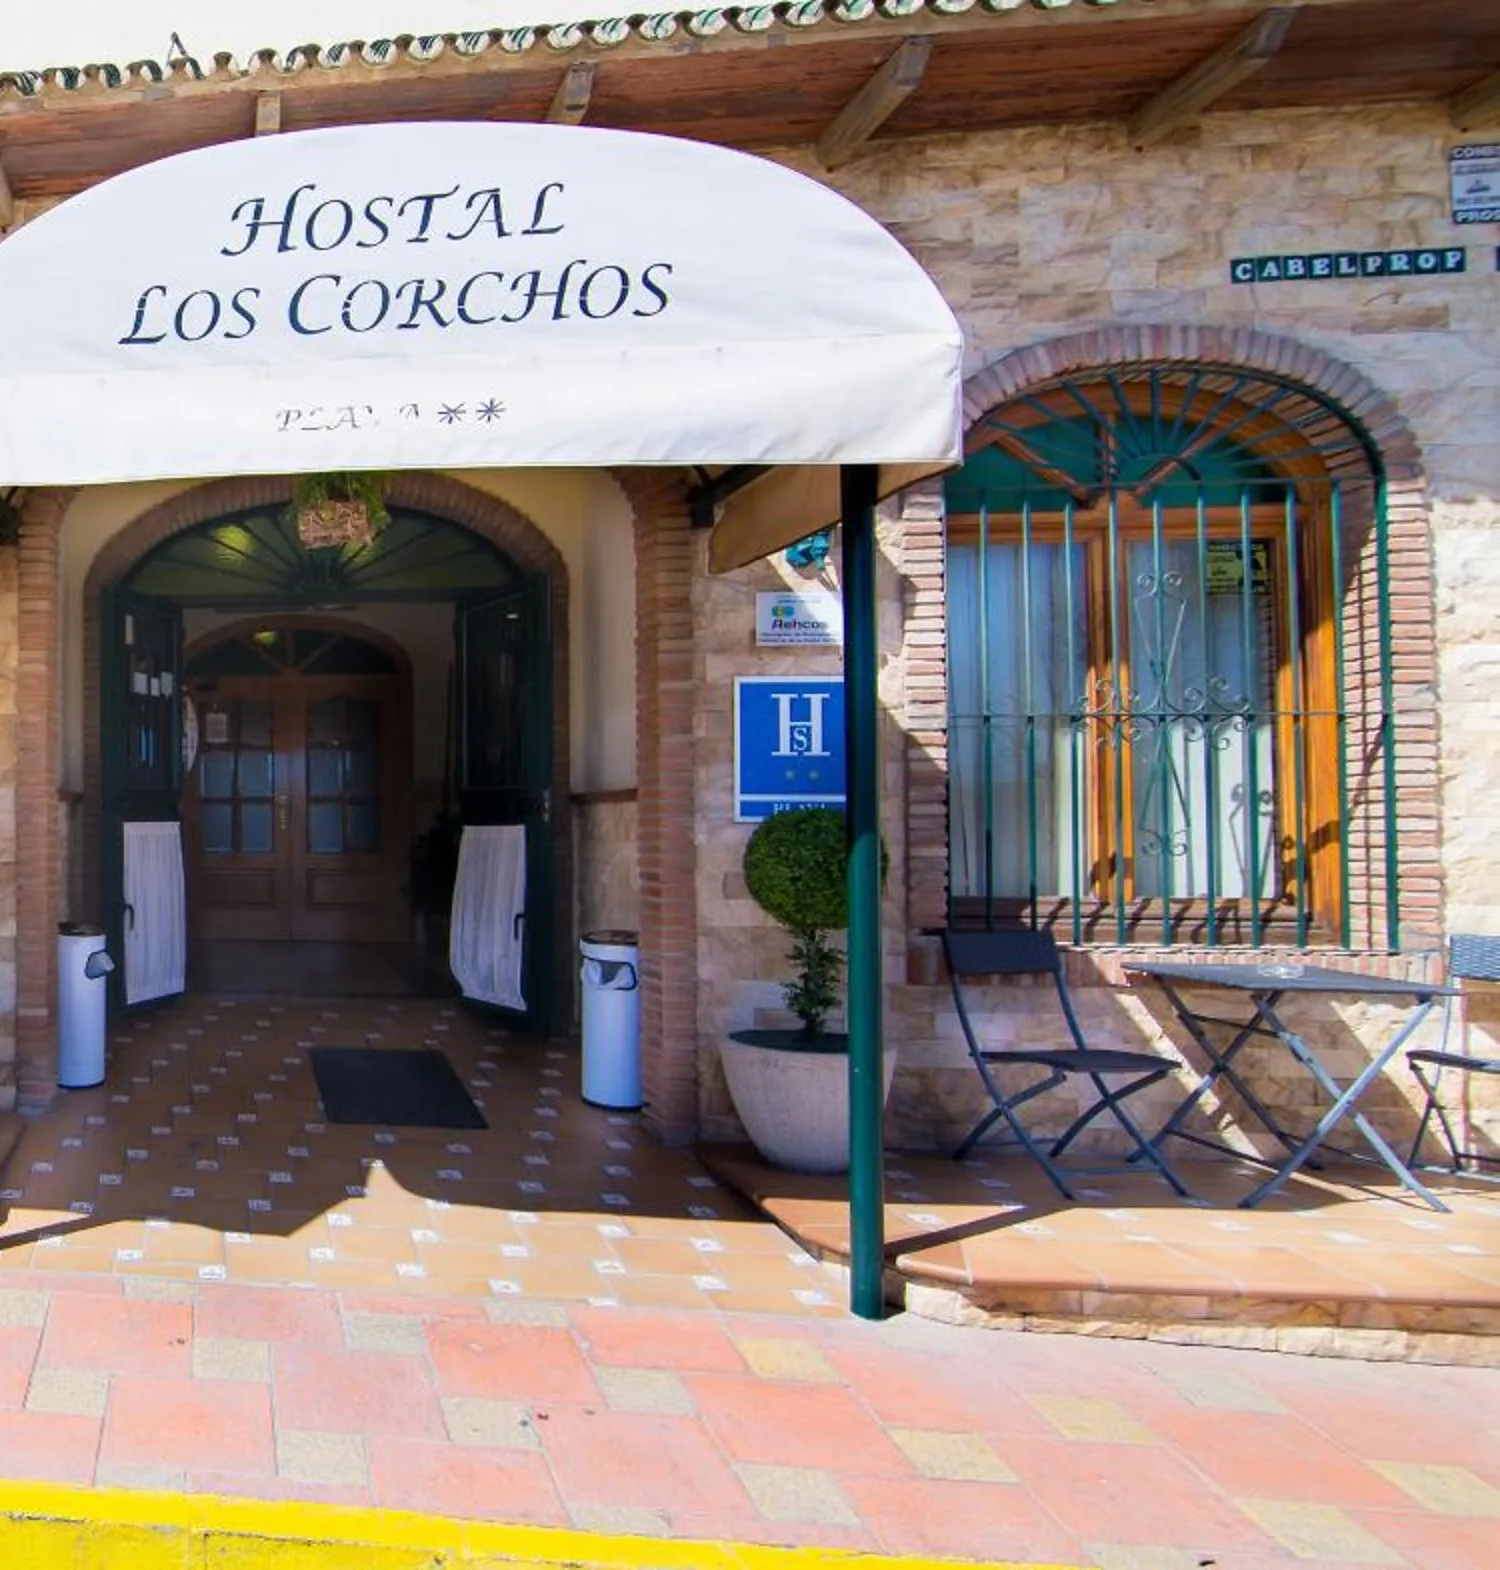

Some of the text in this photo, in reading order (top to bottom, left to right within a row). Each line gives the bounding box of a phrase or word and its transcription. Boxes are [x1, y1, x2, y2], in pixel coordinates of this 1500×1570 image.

[220, 181, 565, 256] HOSTAL
[117, 258, 673, 345] LOS CORCHOS
[1234, 250, 1463, 280] CABELPROP
